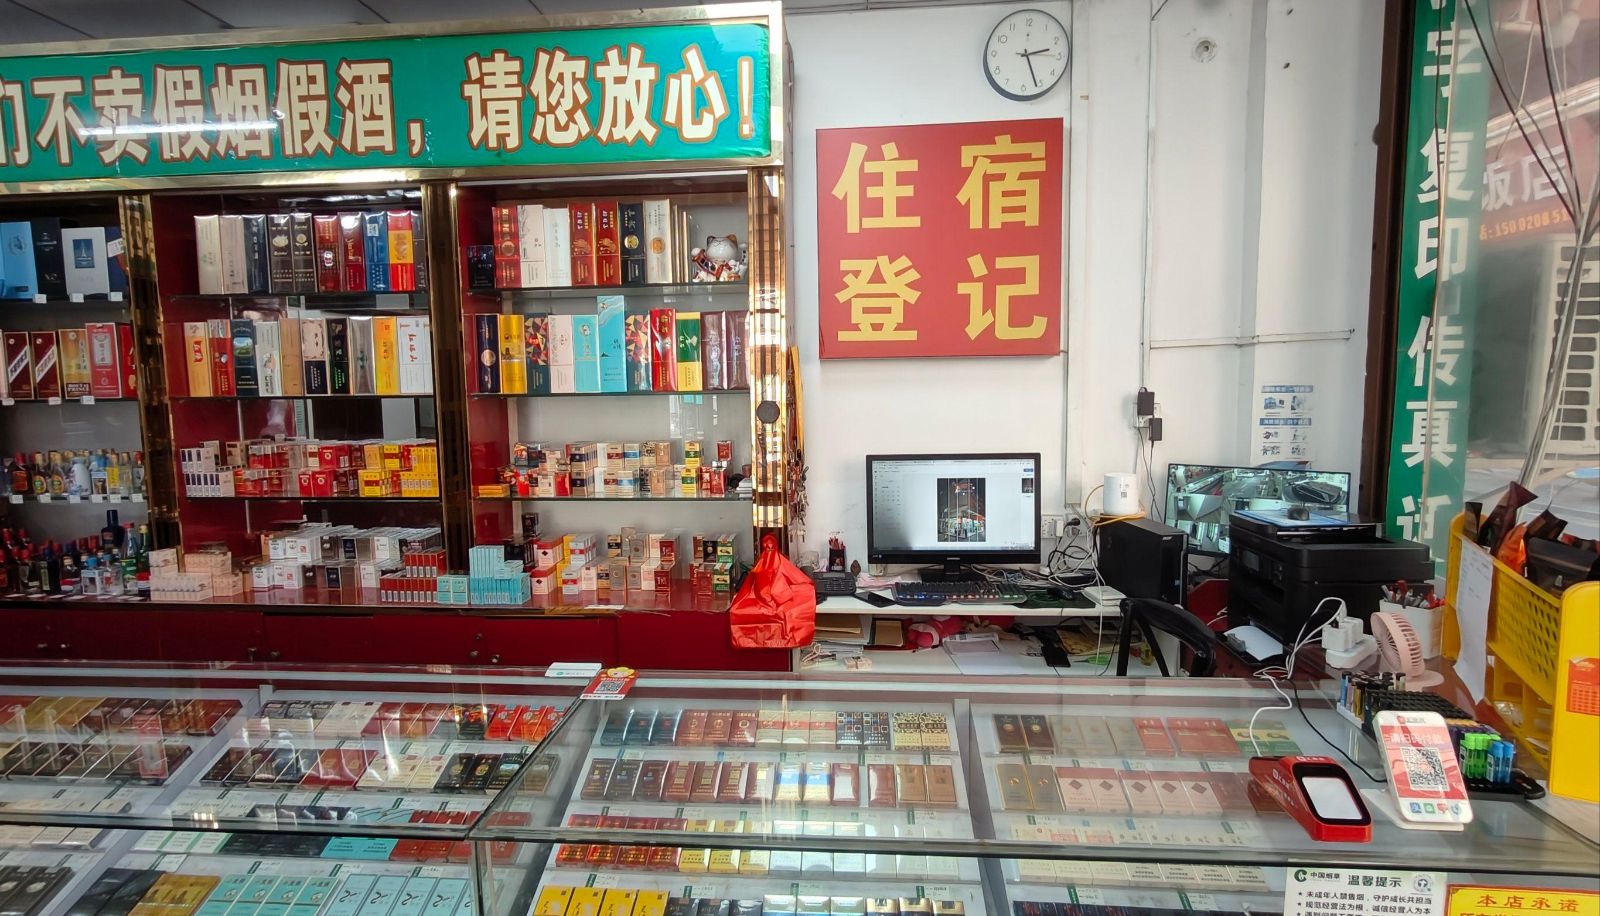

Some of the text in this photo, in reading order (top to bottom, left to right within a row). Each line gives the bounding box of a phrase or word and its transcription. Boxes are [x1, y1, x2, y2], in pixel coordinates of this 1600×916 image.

[1025, 17, 1033, 27] 12
[997, 34, 1008, 44] 10
[1053, 35, 1060, 45] 2
[831, 134, 1047, 234] 住宿
[834, 254, 1048, 342] 登记
[1348, 874, 1402, 888] 温馨提示
[1477, 894, 1580, 912] 本店承诺
